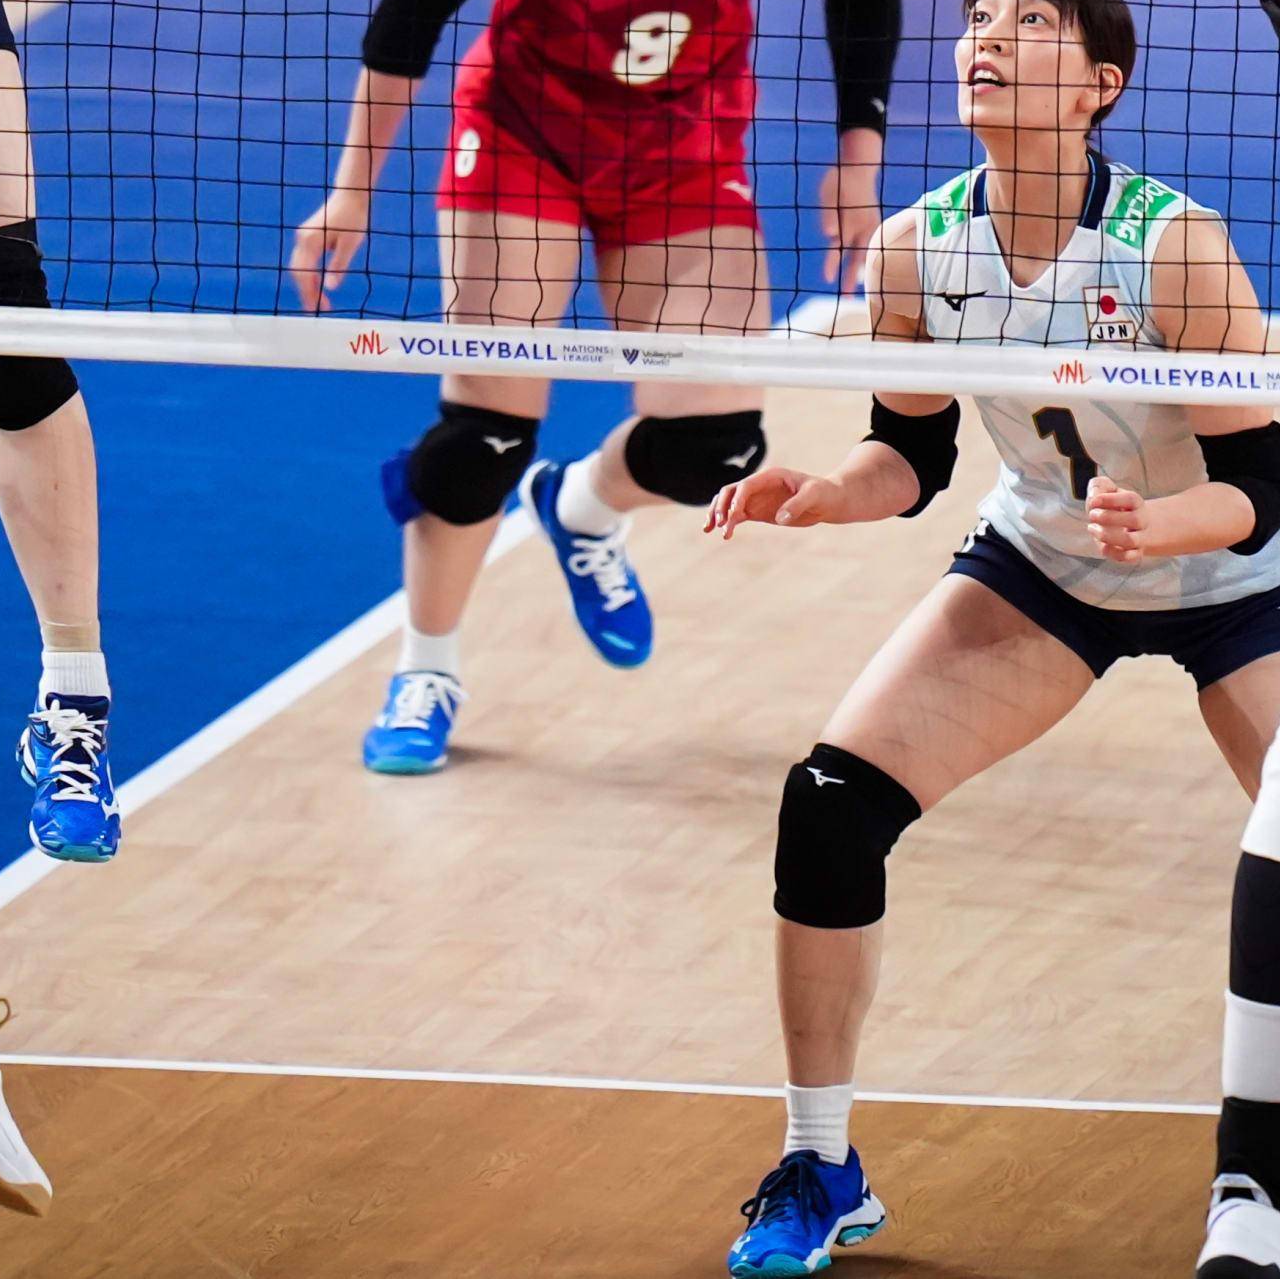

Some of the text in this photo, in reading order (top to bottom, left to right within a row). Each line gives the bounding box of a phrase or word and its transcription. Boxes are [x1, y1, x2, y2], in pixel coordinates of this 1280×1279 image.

[1096, 324, 1129, 340] JPN
[350, 330, 557, 361] VNL VOLLEYBALL
[563, 345, 608, 354] NATIONS
[563, 354, 603, 363] LEAGUE
[1053, 360, 1261, 389] VNL VOLLEYBALL
[1032, 406, 1098, 501] 1
